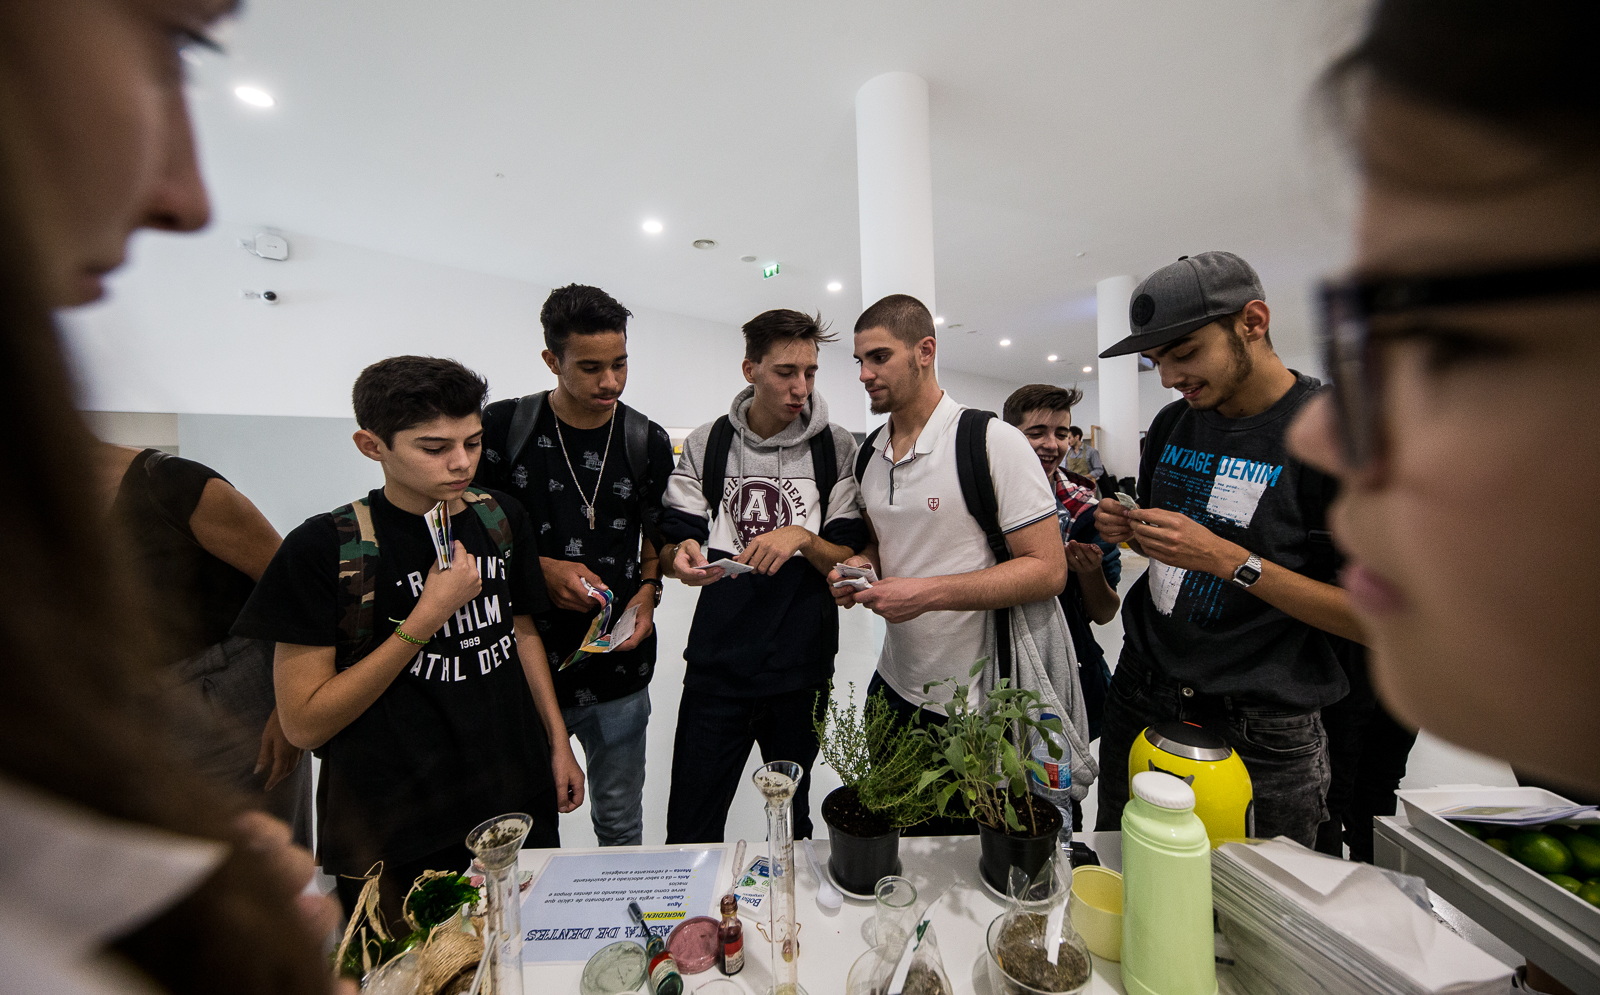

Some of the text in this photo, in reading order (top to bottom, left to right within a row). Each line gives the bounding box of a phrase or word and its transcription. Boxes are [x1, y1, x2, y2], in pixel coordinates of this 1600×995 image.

[1160, 444, 1283, 487] INTAGE DENIM
[742, 489, 770, 522] A
[774, 477, 807, 519] DEMY
[459, 636, 481, 650] 1989
[477, 627, 518, 675] DEP
[525, 925, 673, 941] ASTA DE DENTES
